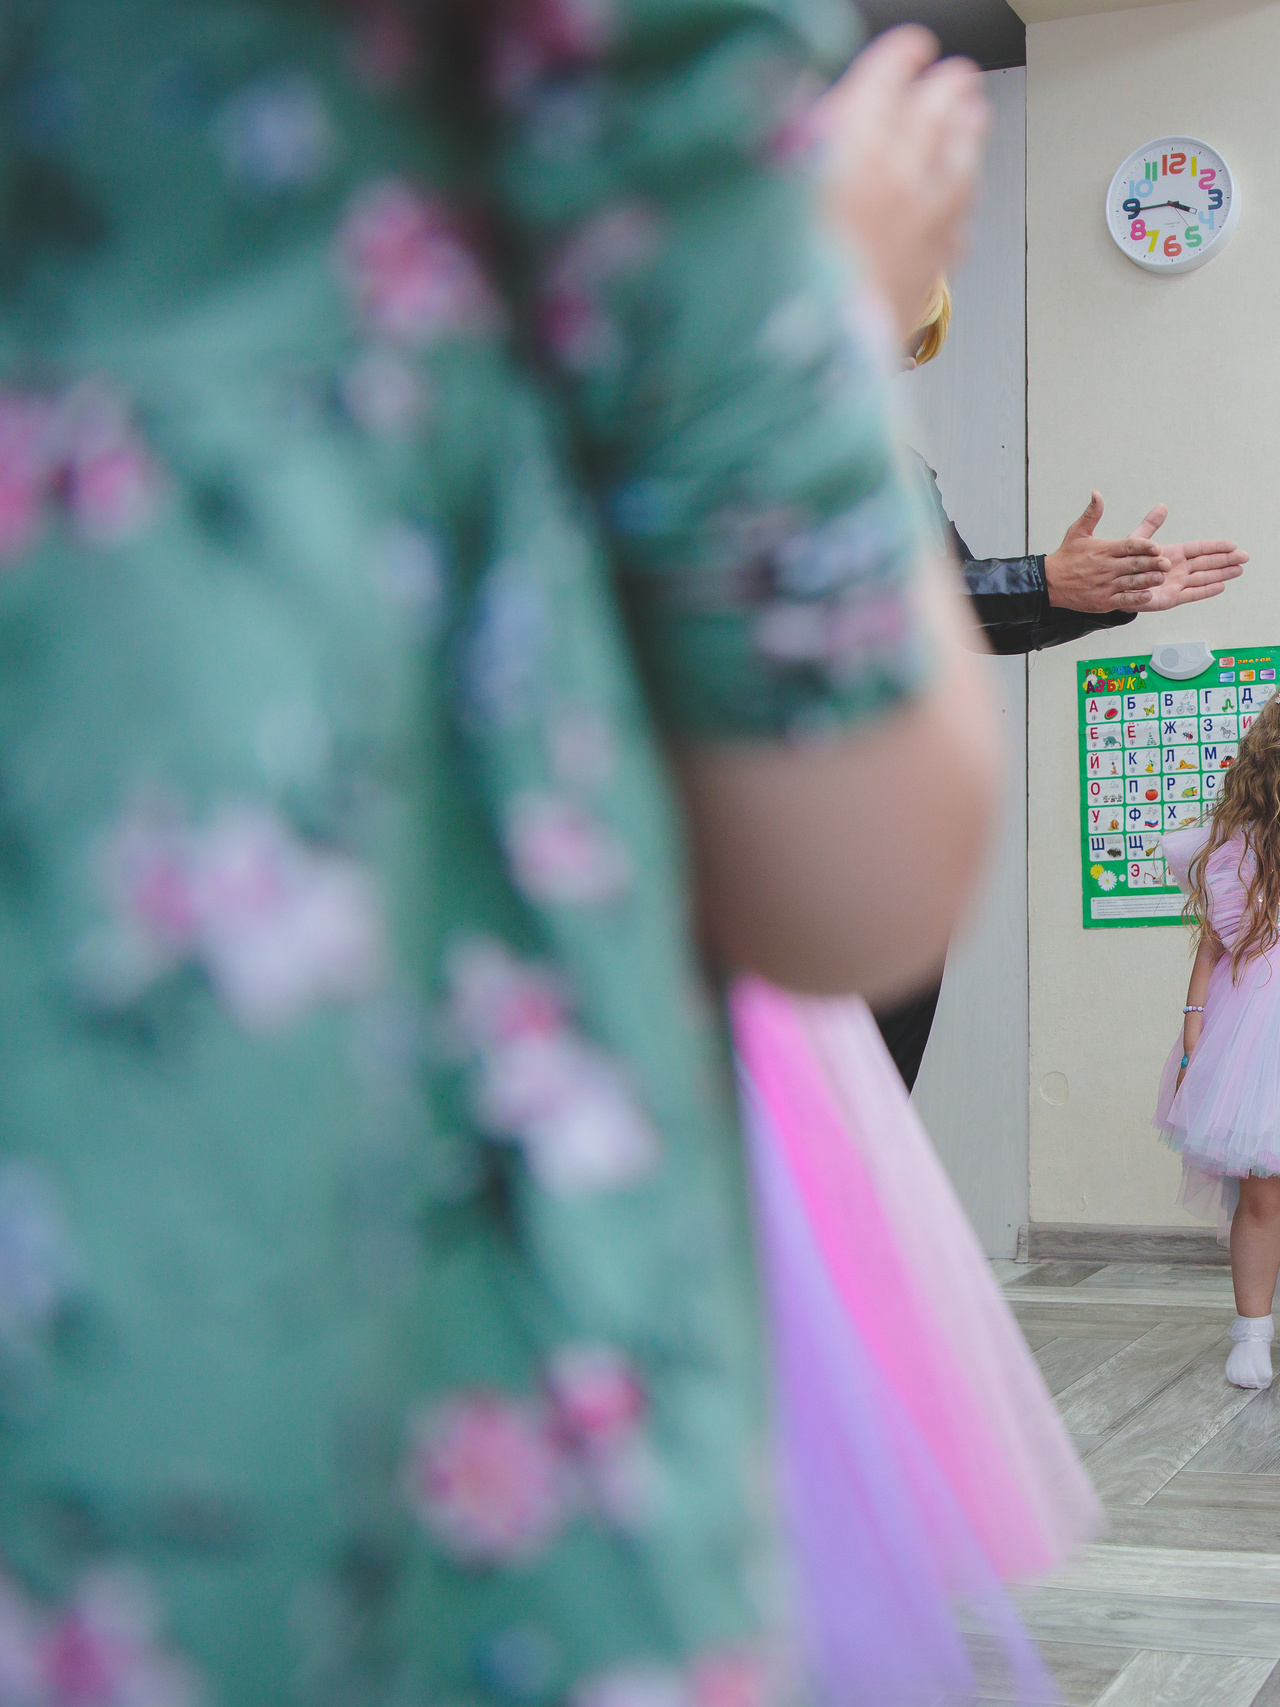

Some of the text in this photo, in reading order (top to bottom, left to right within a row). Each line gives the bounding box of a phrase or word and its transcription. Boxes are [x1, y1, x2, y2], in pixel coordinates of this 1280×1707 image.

[1145, 162, 1158, 181] 11
[1162, 152, 1186, 176] 12
[1191, 156, 1197, 177] 1
[1130, 178, 1153, 198] 10
[1198, 168, 1216, 190] 2
[1122, 198, 1141, 220] 9
[1208, 188, 1223, 210] 3
[1130, 219, 1146, 240] 8
[1198, 211, 1214, 230] 4
[1146, 230, 1160, 253] 7
[1164, 235, 1182, 257] 6
[1185, 225, 1202, 247] 5
[1086, 664, 1145, 677] ГОВОРЯЩАЯ
[1086, 676, 1147, 694] АЗБУКА
[1089, 700, 1098, 712] А
[1127, 697, 1136, 709] Б
[1165, 694, 1173, 706] В
[1205, 691, 1212, 704] Г
[1242, 688, 1253, 704] Д
[1090, 727, 1099, 740] Е
[1128, 722, 1136, 738] Ё
[1164, 721, 1177, 734] Ж
[1204, 719, 1213, 731] З
[1242, 716, 1252, 729] И
[1090, 753, 1099, 769] Й
[1129, 752, 1137, 765] К
[1165, 749, 1174, 762] Л
[1204, 747, 1217, 760] М
[1091, 782, 1100, 795] О
[1129, 780, 1138, 793] П
[1167, 778, 1176, 790] Р
[1206, 775, 1215, 788] С
[1092, 810, 1100, 823] У
[1129, 808, 1141, 821] Ф
[1168, 806, 1177, 819] Х
[1091, 838, 1105, 850] Ш
[1129, 836, 1143, 851] Щ
[1130, 864, 1140, 877] Э
